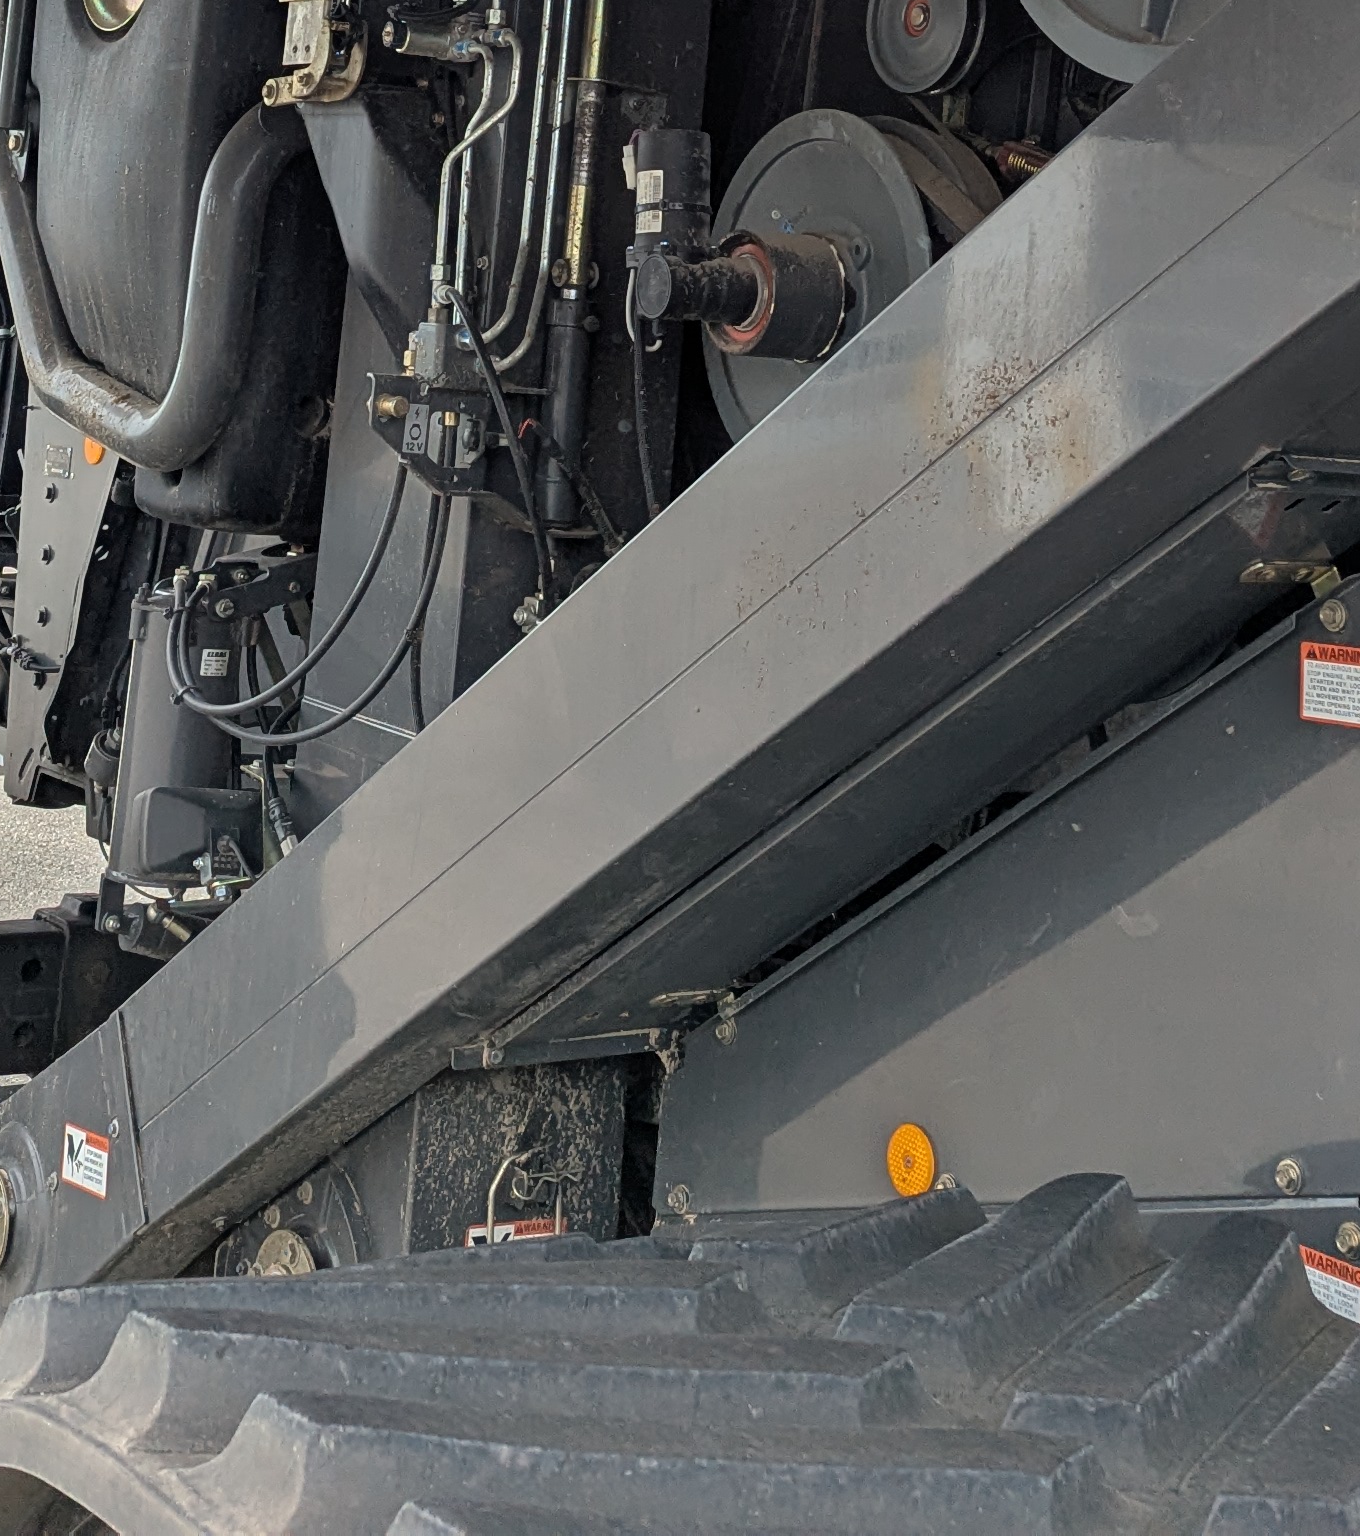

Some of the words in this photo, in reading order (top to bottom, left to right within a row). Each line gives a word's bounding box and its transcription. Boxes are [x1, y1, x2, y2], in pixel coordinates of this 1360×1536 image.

[406, 442, 415, 451] 12
[417, 443, 423, 451] V
[1308, 684, 1327, 692] LISTEN
[1316, 693, 1346, 701] MOVEMENT
[1327, 701, 1350, 710] OPENING
